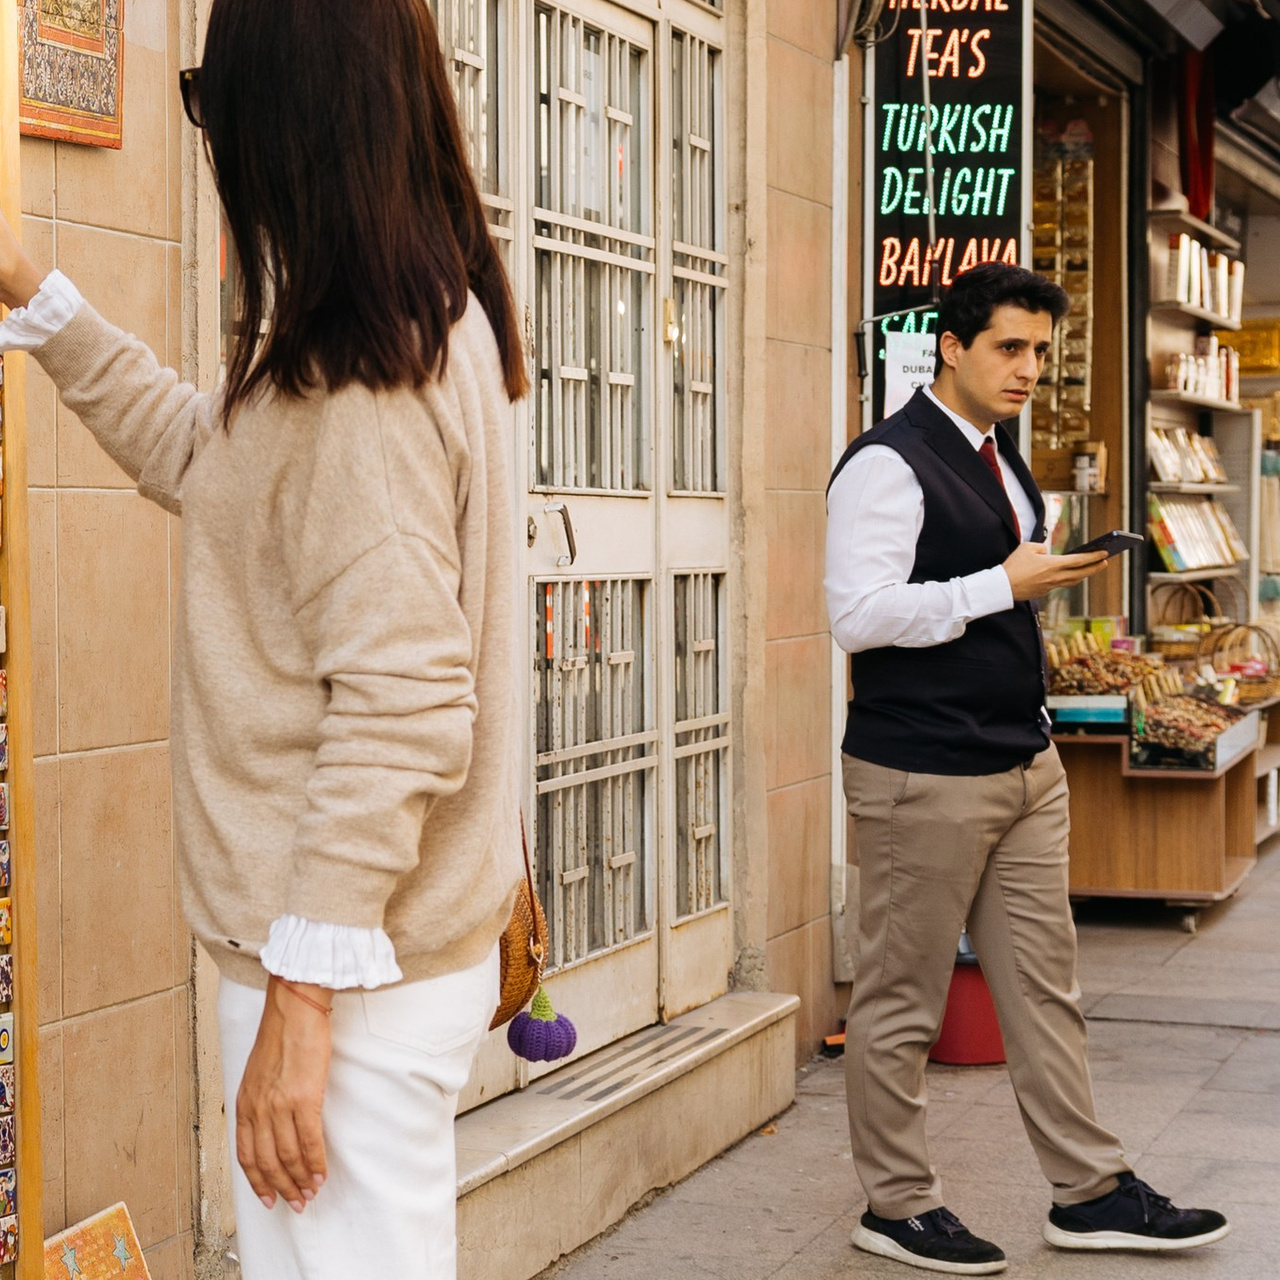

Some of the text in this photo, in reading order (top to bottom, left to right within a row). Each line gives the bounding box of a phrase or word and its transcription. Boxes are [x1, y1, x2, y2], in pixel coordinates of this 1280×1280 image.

[906, 28, 991, 78] TEA'S
[881, 103, 1014, 154] TURKISH
[902, 365, 933, 374] DUBA
